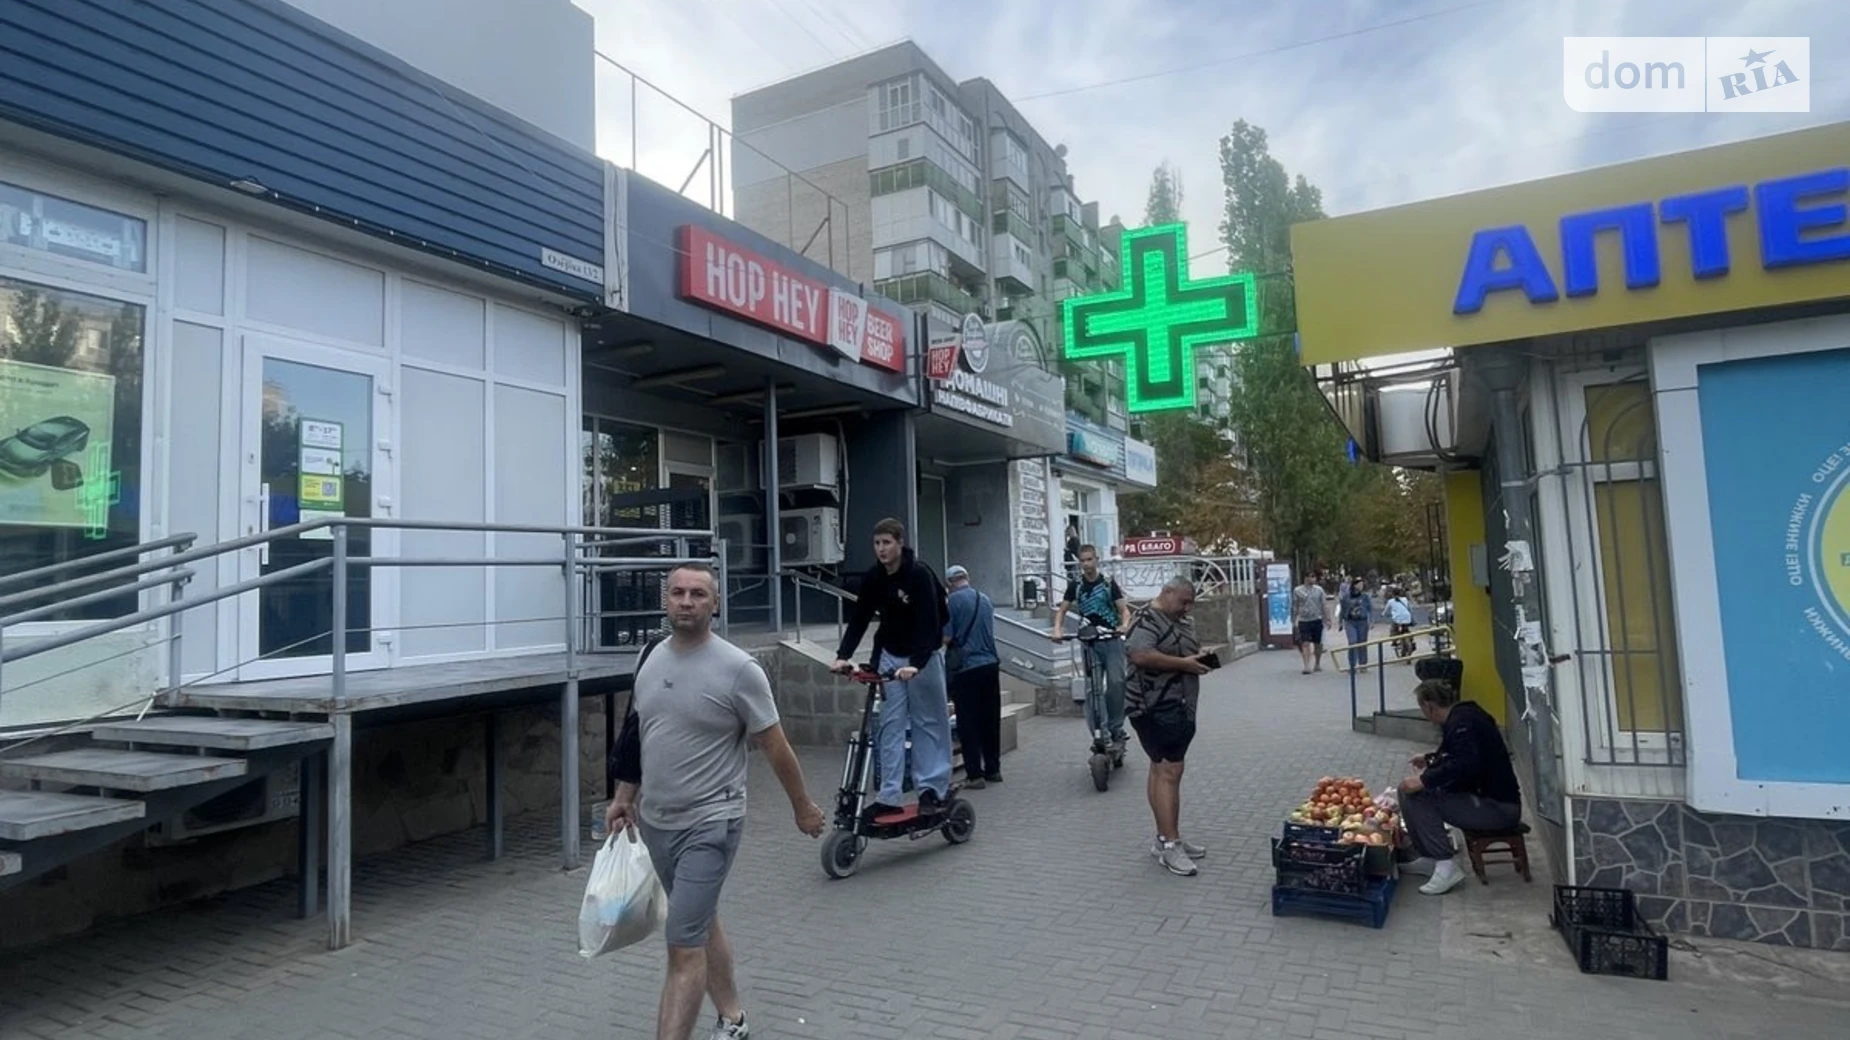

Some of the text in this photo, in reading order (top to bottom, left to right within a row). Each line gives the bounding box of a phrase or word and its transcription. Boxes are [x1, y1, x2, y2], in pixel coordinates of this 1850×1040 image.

[1452, 166, 1850, 315] АПТЕ
[706, 242, 820, 335] HOP HEY
[838, 295, 859, 325] HOP
[838, 319, 859, 347] HEY
[866, 312, 894, 343] BEER
[866, 336, 894, 364] SHOP
[931, 348, 951, 361] HOP
[931, 360, 950, 375] HEY
